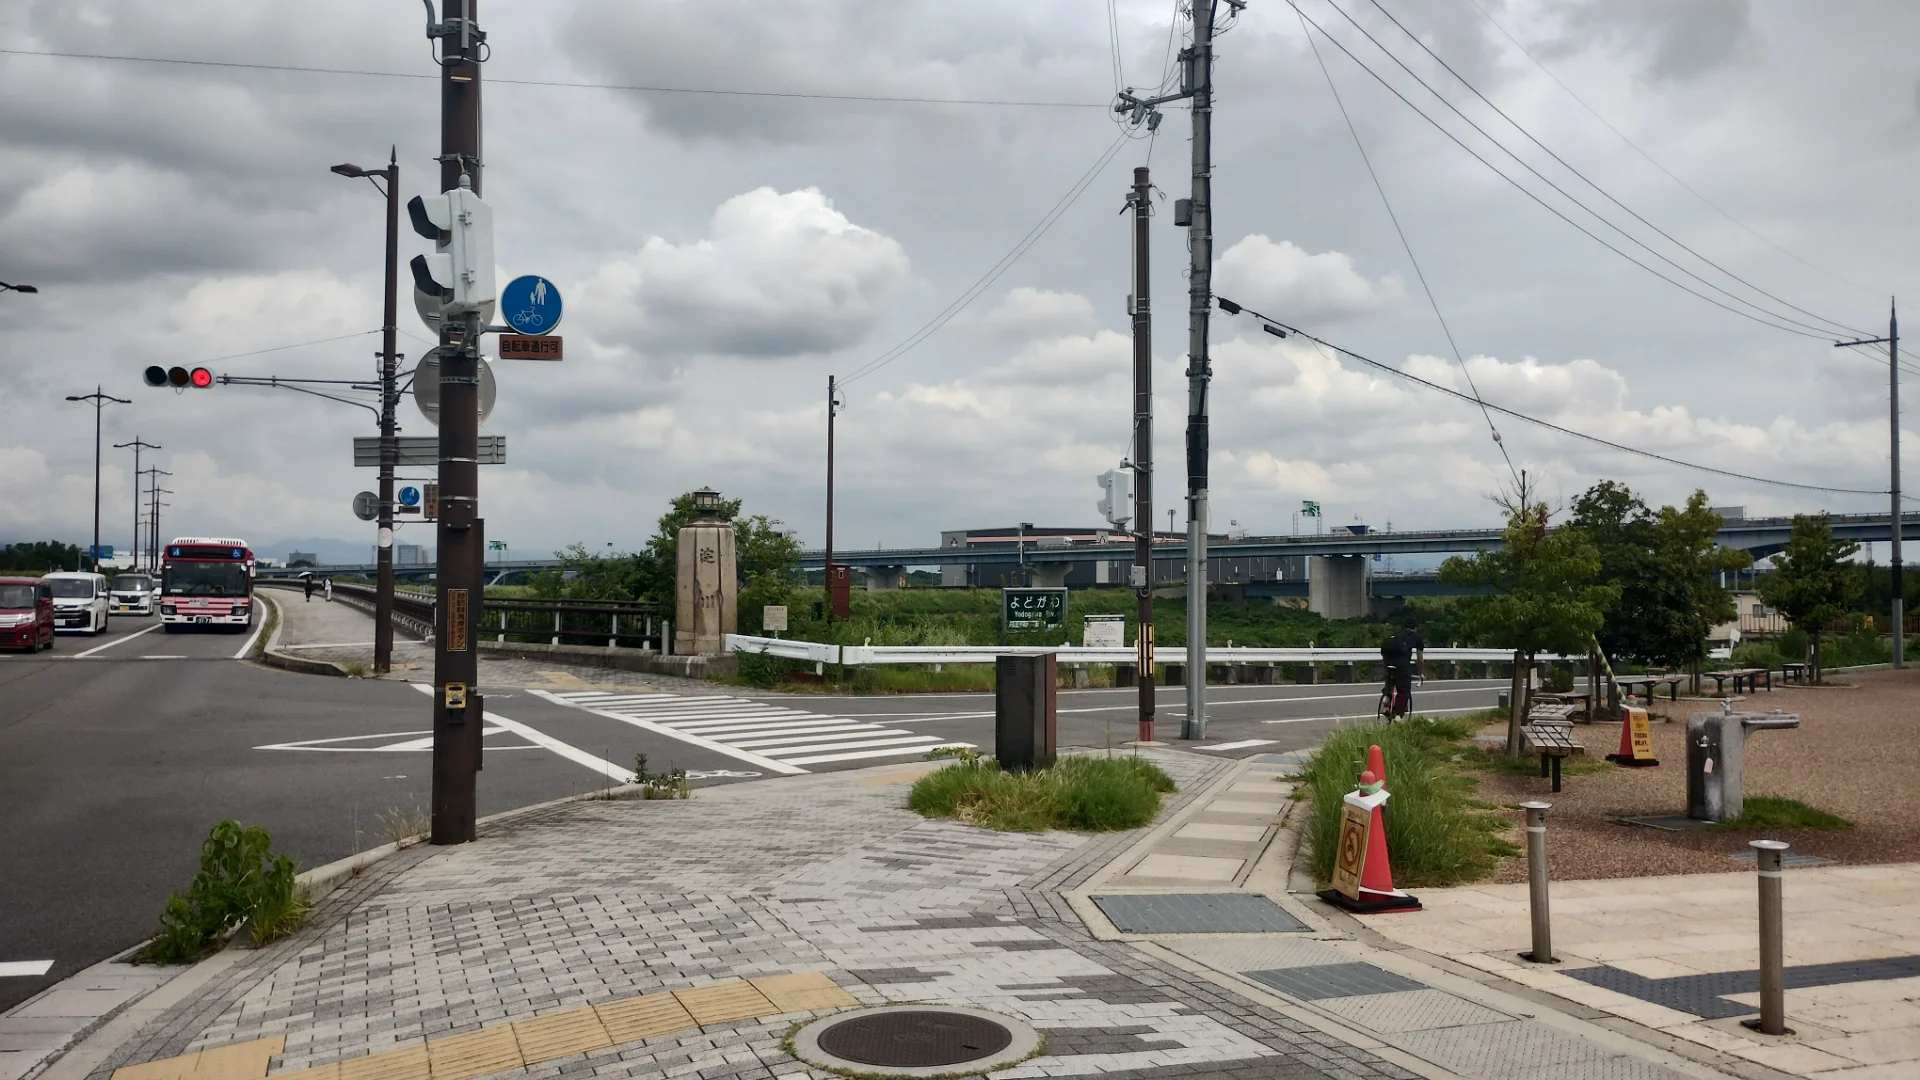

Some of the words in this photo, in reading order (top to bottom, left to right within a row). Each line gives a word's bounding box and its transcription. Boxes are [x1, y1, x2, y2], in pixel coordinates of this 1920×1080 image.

[502, 340, 559, 353] 自転車通行可
